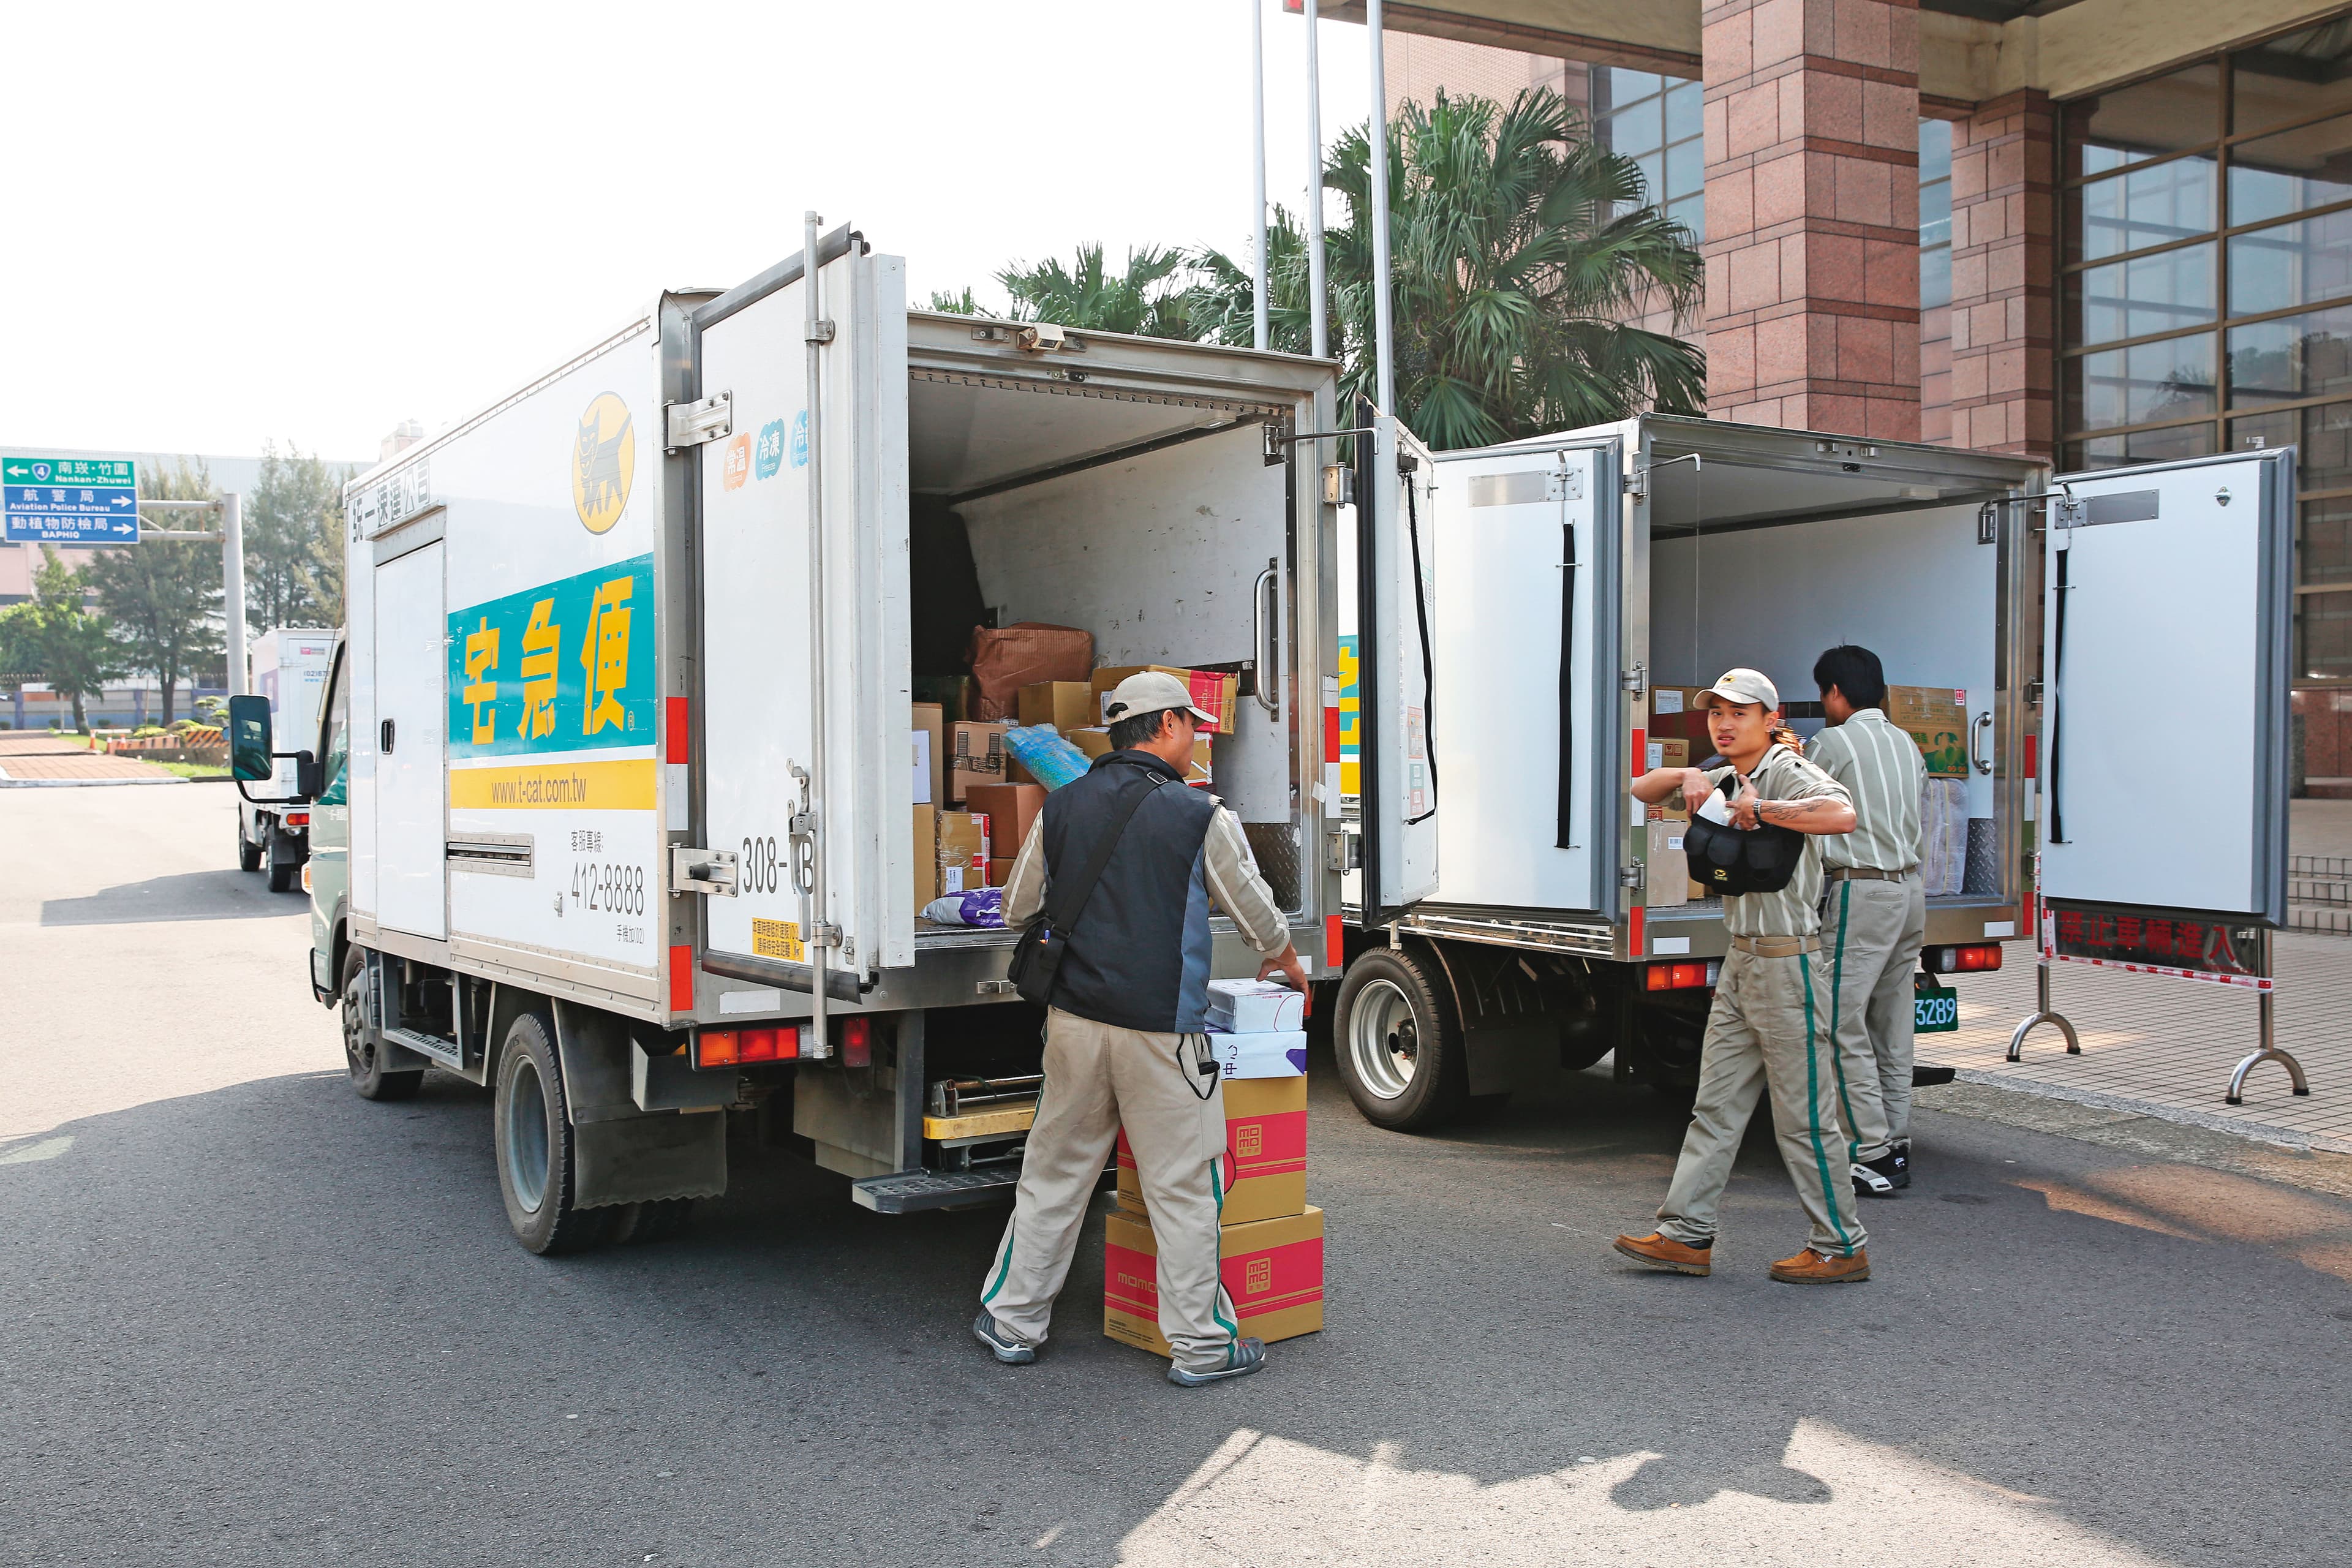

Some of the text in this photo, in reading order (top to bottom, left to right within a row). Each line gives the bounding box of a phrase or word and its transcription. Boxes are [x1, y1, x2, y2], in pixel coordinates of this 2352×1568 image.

[727, 446, 745, 475] 常溫
[760, 430, 780, 461] 冷凍
[37, 466, 45, 477] 4
[23, 489, 94, 502] 航警局
[353, 459, 429, 543] 統一速達公司
[12, 516, 108, 530] 動植物防檢局
[463, 576, 633, 745] 宅急便
[491, 771, 587, 803] www.t-cat.com.tw
[743, 835, 813, 894] 308-B
[571, 862, 644, 916] 412-8888
[2060, 911, 2235, 963] 禁止車輛進入
[1914, 998, 1956, 1025] 3289
[1223, 1044, 1238, 1080] 中心
[1118, 1272, 1157, 1294] momo
